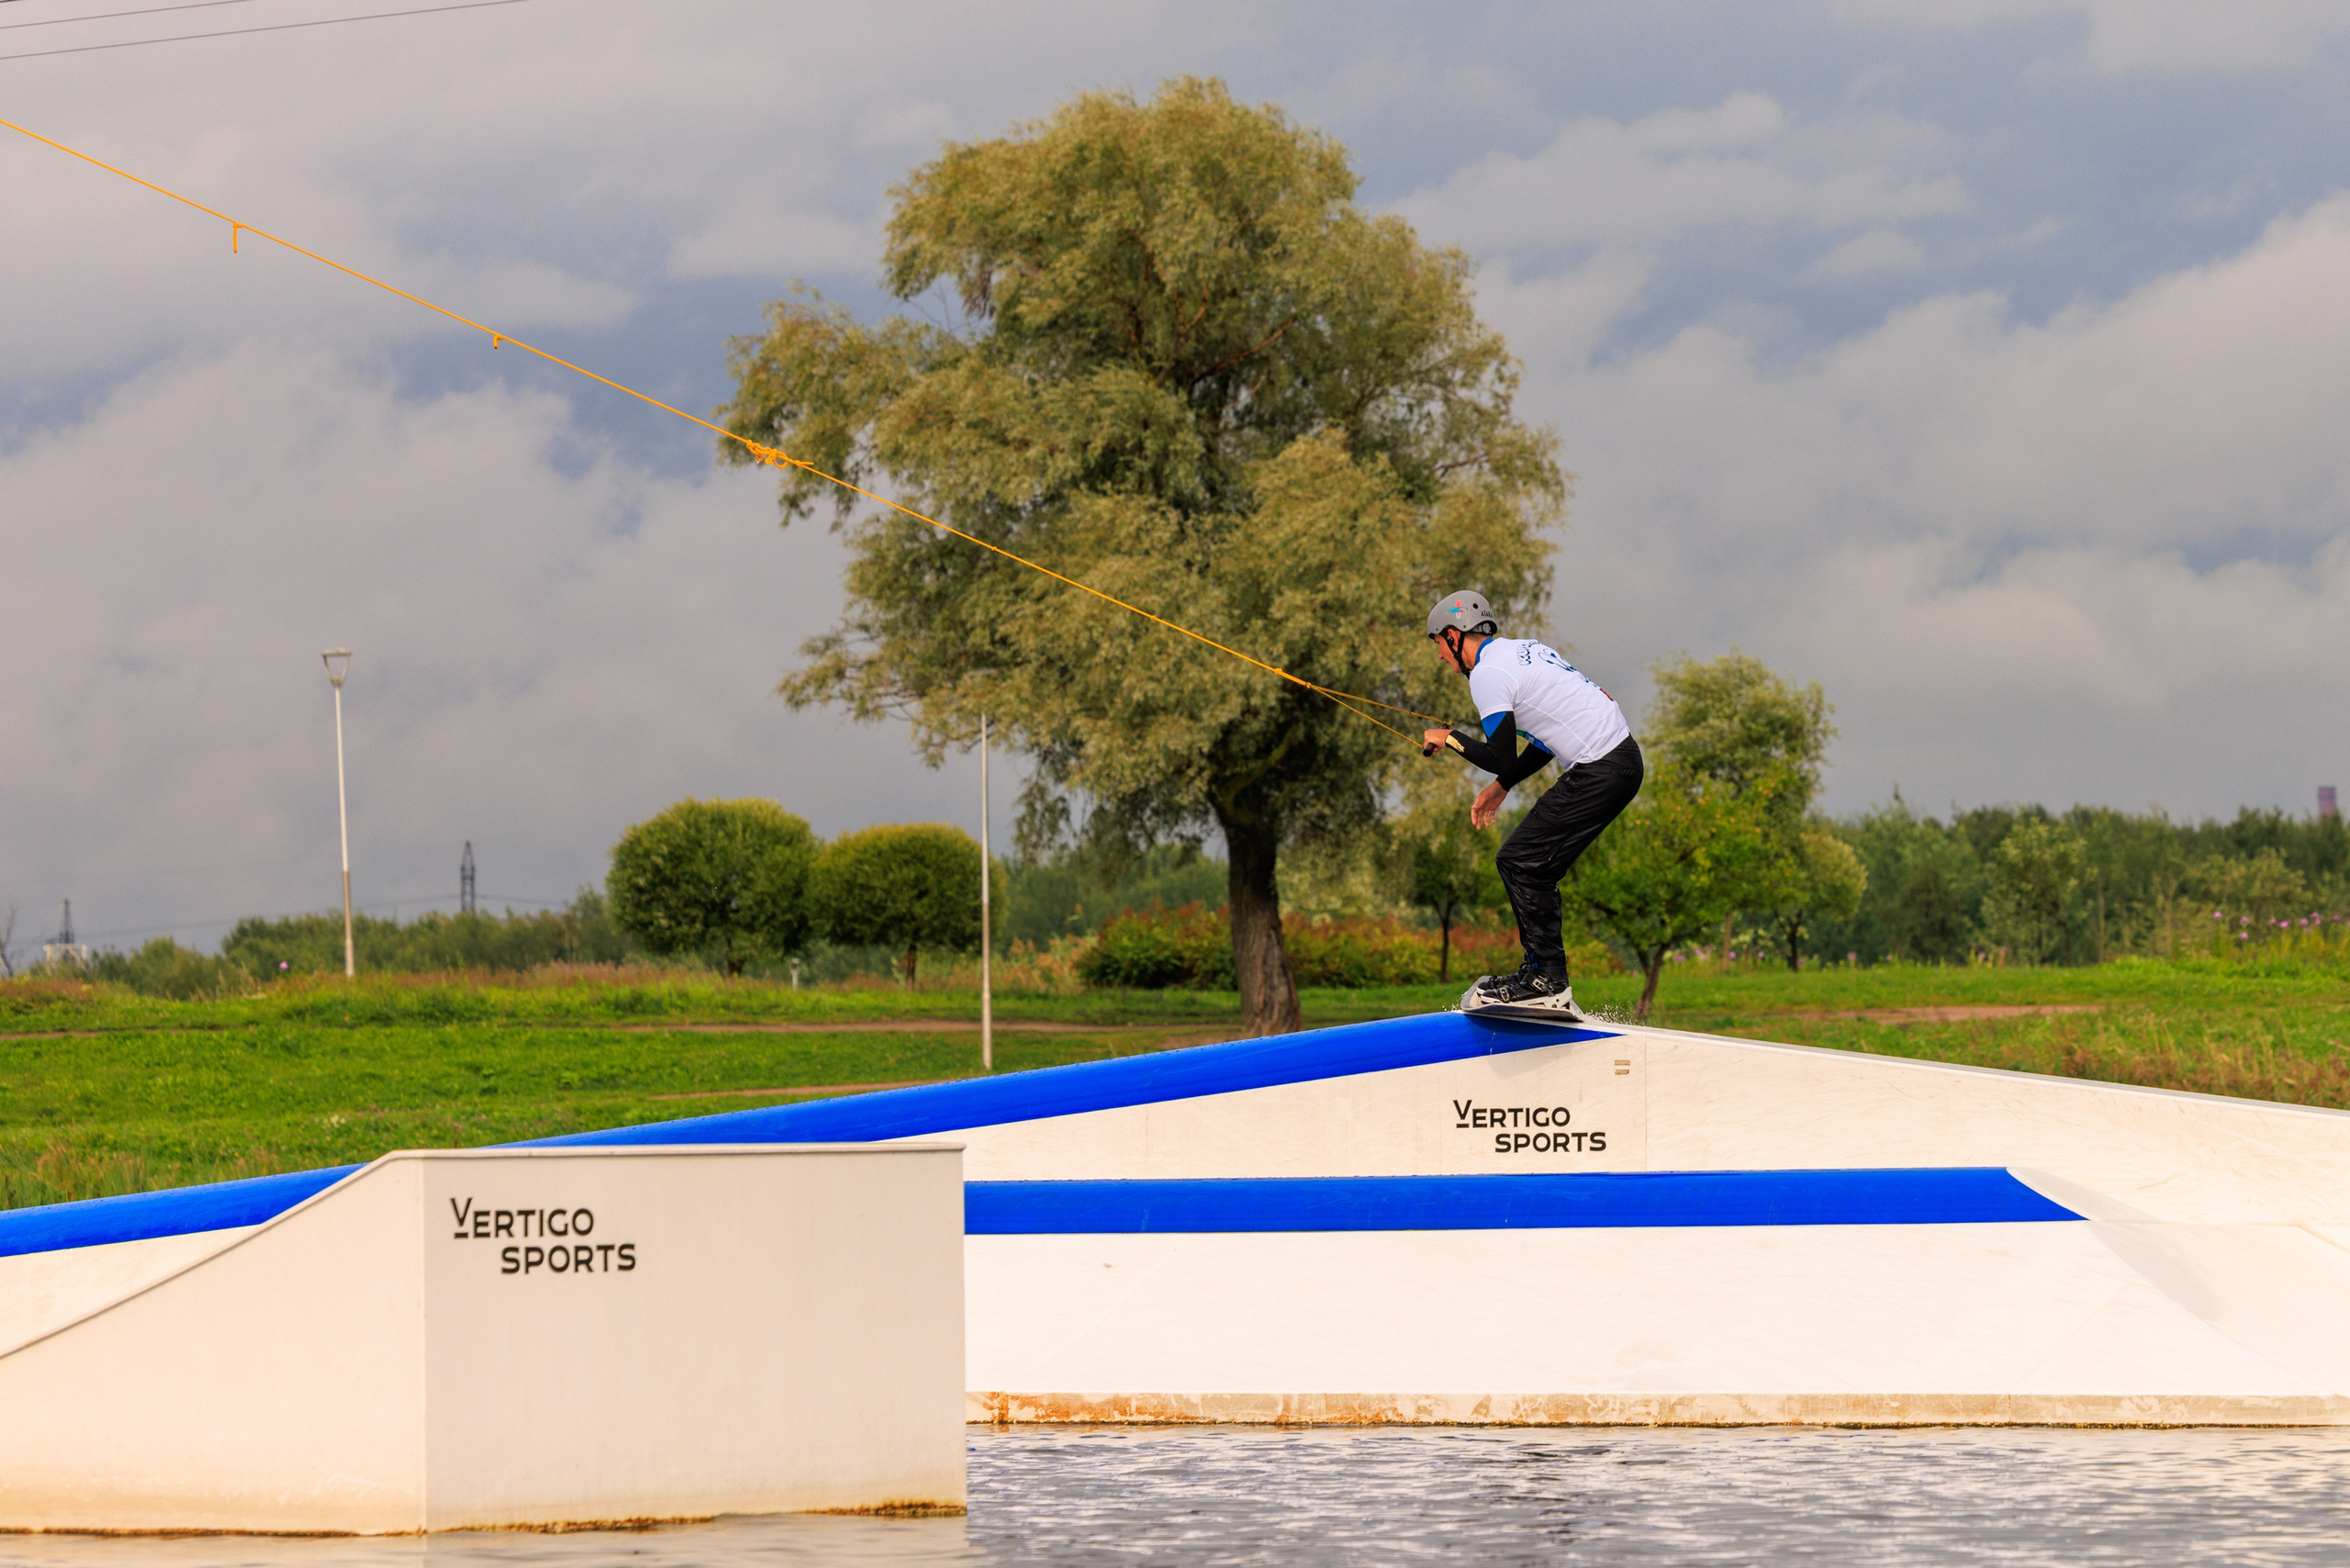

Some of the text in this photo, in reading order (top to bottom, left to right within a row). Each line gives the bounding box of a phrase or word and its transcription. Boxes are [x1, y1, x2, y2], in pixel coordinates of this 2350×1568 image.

[1452, 1099, 1571, 1129] VERTIGO
[1494, 1131, 1606, 1153] SPORTS
[450, 1197, 595, 1239] VERTIGO
[501, 1243, 636, 1275] SPORTS
